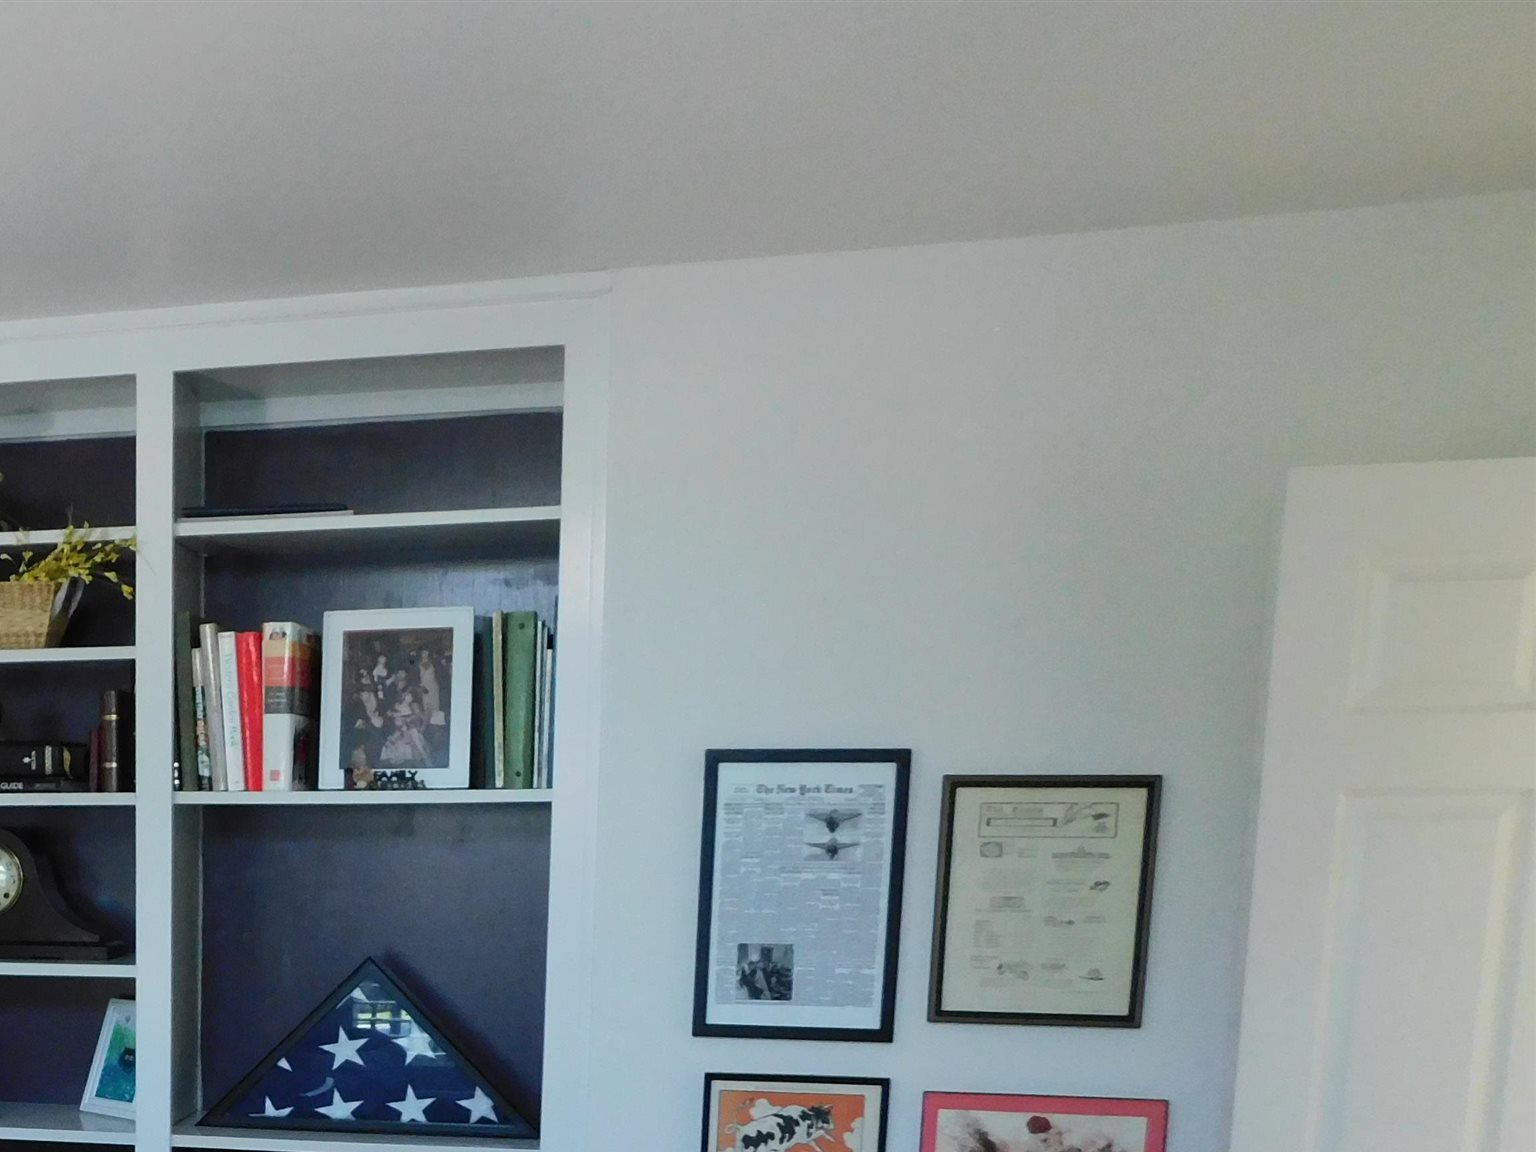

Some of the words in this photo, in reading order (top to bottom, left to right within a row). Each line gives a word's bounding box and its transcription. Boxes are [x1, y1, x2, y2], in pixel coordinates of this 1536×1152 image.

[0, 782, 24, 790] GUIDE
[756, 784, 775, 795] The
[776, 784, 797, 795] New
[799, 784, 822, 796] York
[824, 784, 854, 794] Times
